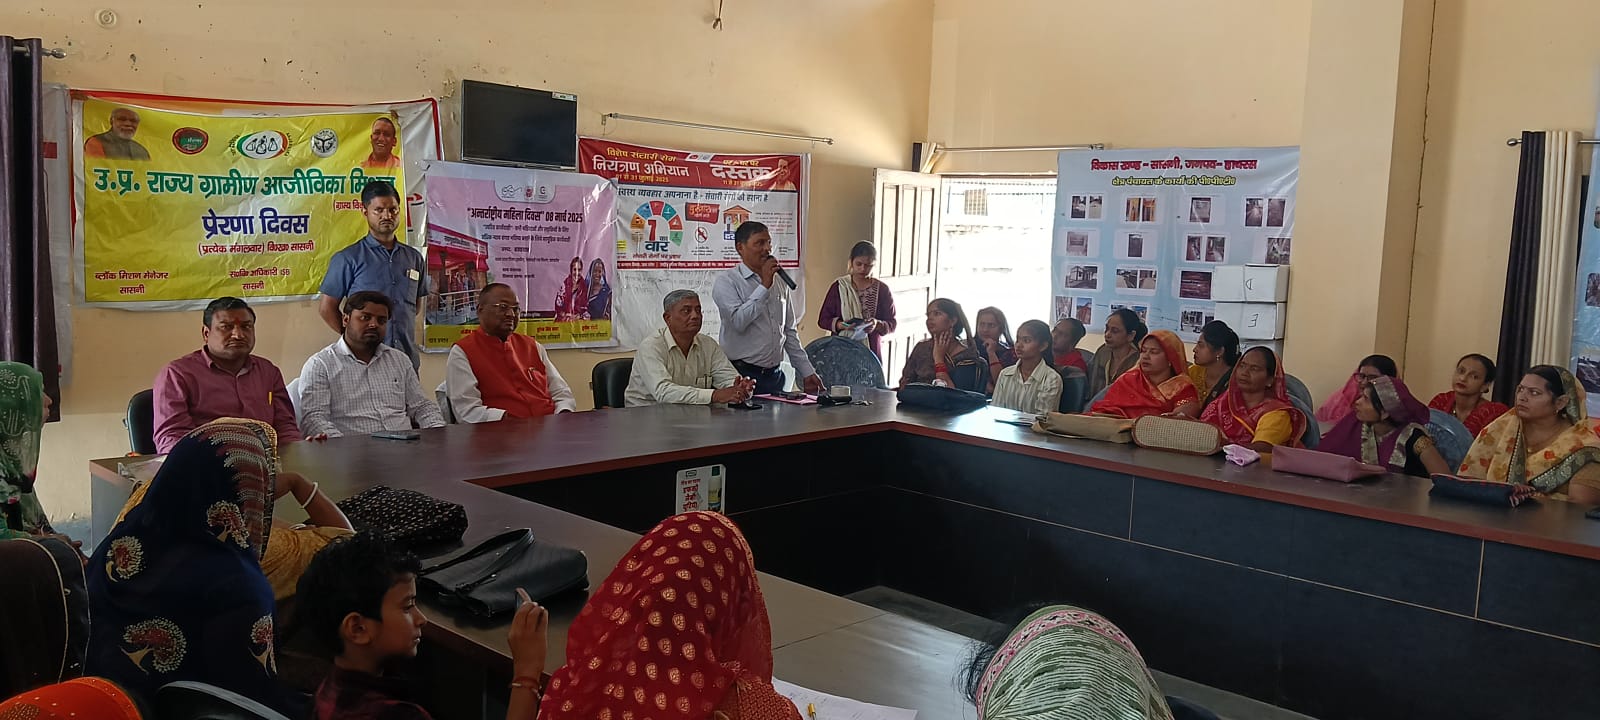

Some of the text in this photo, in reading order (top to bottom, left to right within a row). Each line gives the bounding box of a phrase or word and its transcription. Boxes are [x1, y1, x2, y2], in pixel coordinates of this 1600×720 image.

[592, 154, 690, 177] नियंत्रण अभियान
[1091, 158, 1119, 171] विकास
[710, 163, 773, 180] दस्तक
[94, 168, 140, 196] उ.प्र.
[147, 171, 193, 194] राज्य
[198, 168, 259, 198] ग्रामीण
[261, 168, 346, 195] आजीविका
[1154, 175, 1163, 186] के
[1187, 175, 1198, 185] की
[638, 188, 662, 198] व्यवहार
[664, 189, 691, 199] अपनाना
[503, 206, 524, 221] महिला
[545, 211, 554, 222] 08
[555, 210, 567, 223] मार्च
[567, 212, 583, 223] 2025
[202, 207, 310, 239] प्रेरणा दिवस
[198, 242, 227, 256] (प्रत्येक
[290, 239, 314, 251] सासनी
[644, 240, 670, 252] वार
[95, 270, 117, 280] ब्लॉक
[119, 269, 141, 280] मिशन
[250, 266, 277, 277] अधिकारी
[119, 283, 145, 294] सासनी
[242, 280, 265, 290] सासनी
